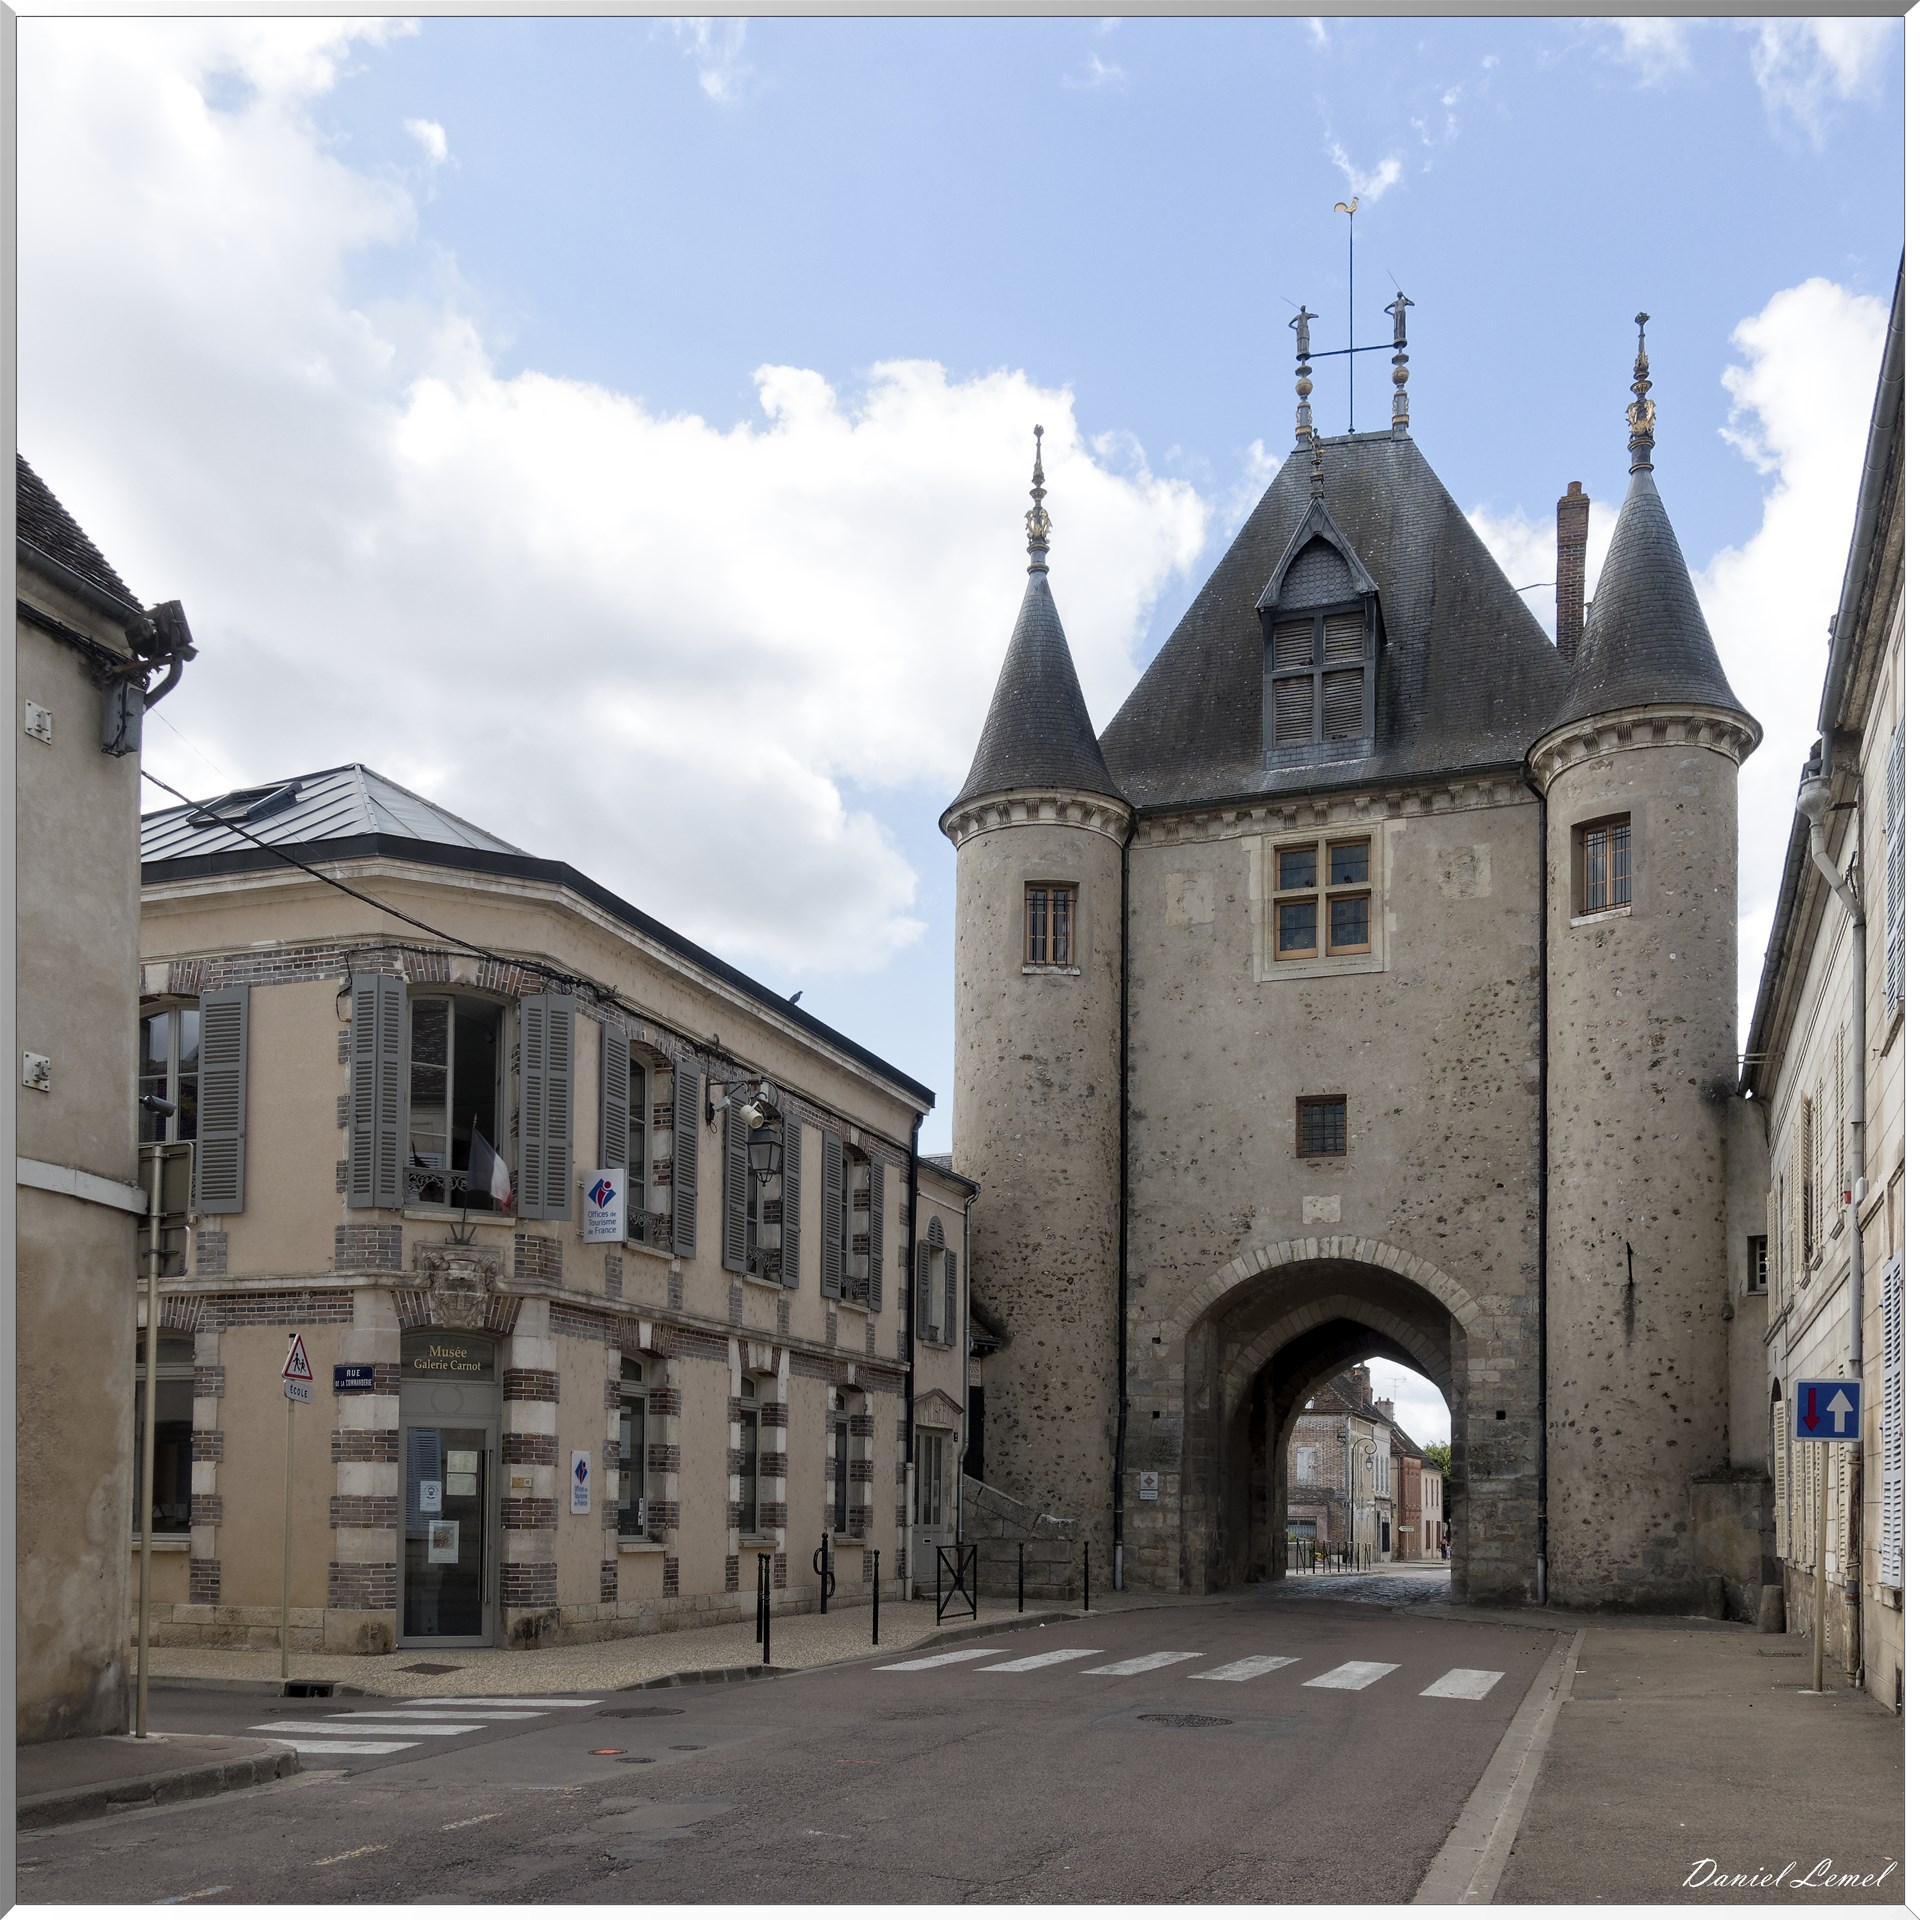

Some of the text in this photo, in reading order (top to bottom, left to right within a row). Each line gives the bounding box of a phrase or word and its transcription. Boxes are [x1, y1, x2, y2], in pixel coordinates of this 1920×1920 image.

[588, 1219, 617, 1227] Tourisme
[594, 1226, 617, 1234] France
[428, 1344, 468, 1358] Musée
[413, 1358, 482, 1371] Galerie Carnot
[346, 1369, 361, 1377] RUE
[345, 1378, 373, 1387] COMMANDERIE
[290, 1383, 308, 1399] ÉCOLE
